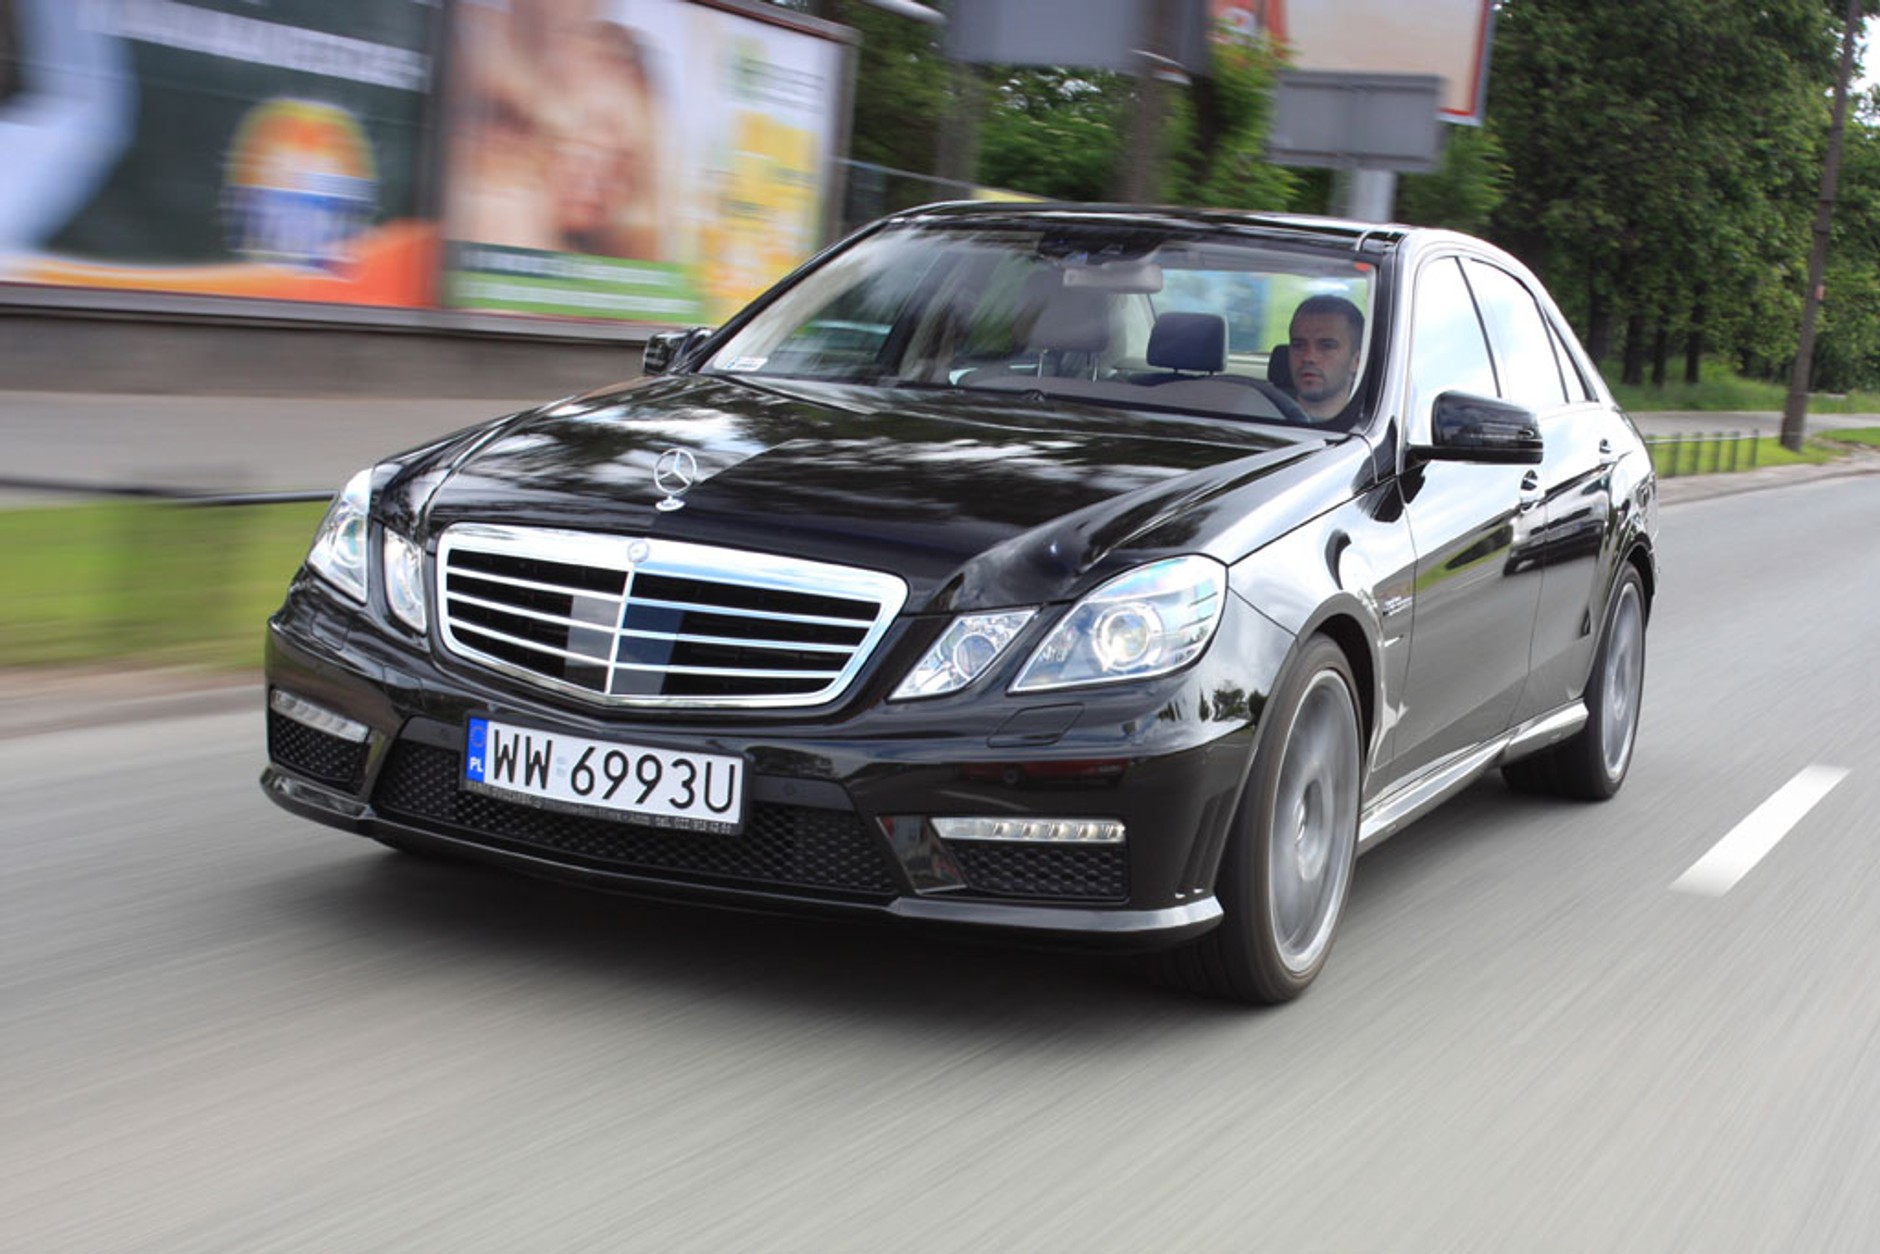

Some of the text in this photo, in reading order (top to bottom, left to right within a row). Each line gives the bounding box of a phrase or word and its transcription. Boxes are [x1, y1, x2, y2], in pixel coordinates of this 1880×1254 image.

[469, 756, 484, 773] PL
[494, 729, 553, 790] WW
[571, 746, 736, 813] 6993U
